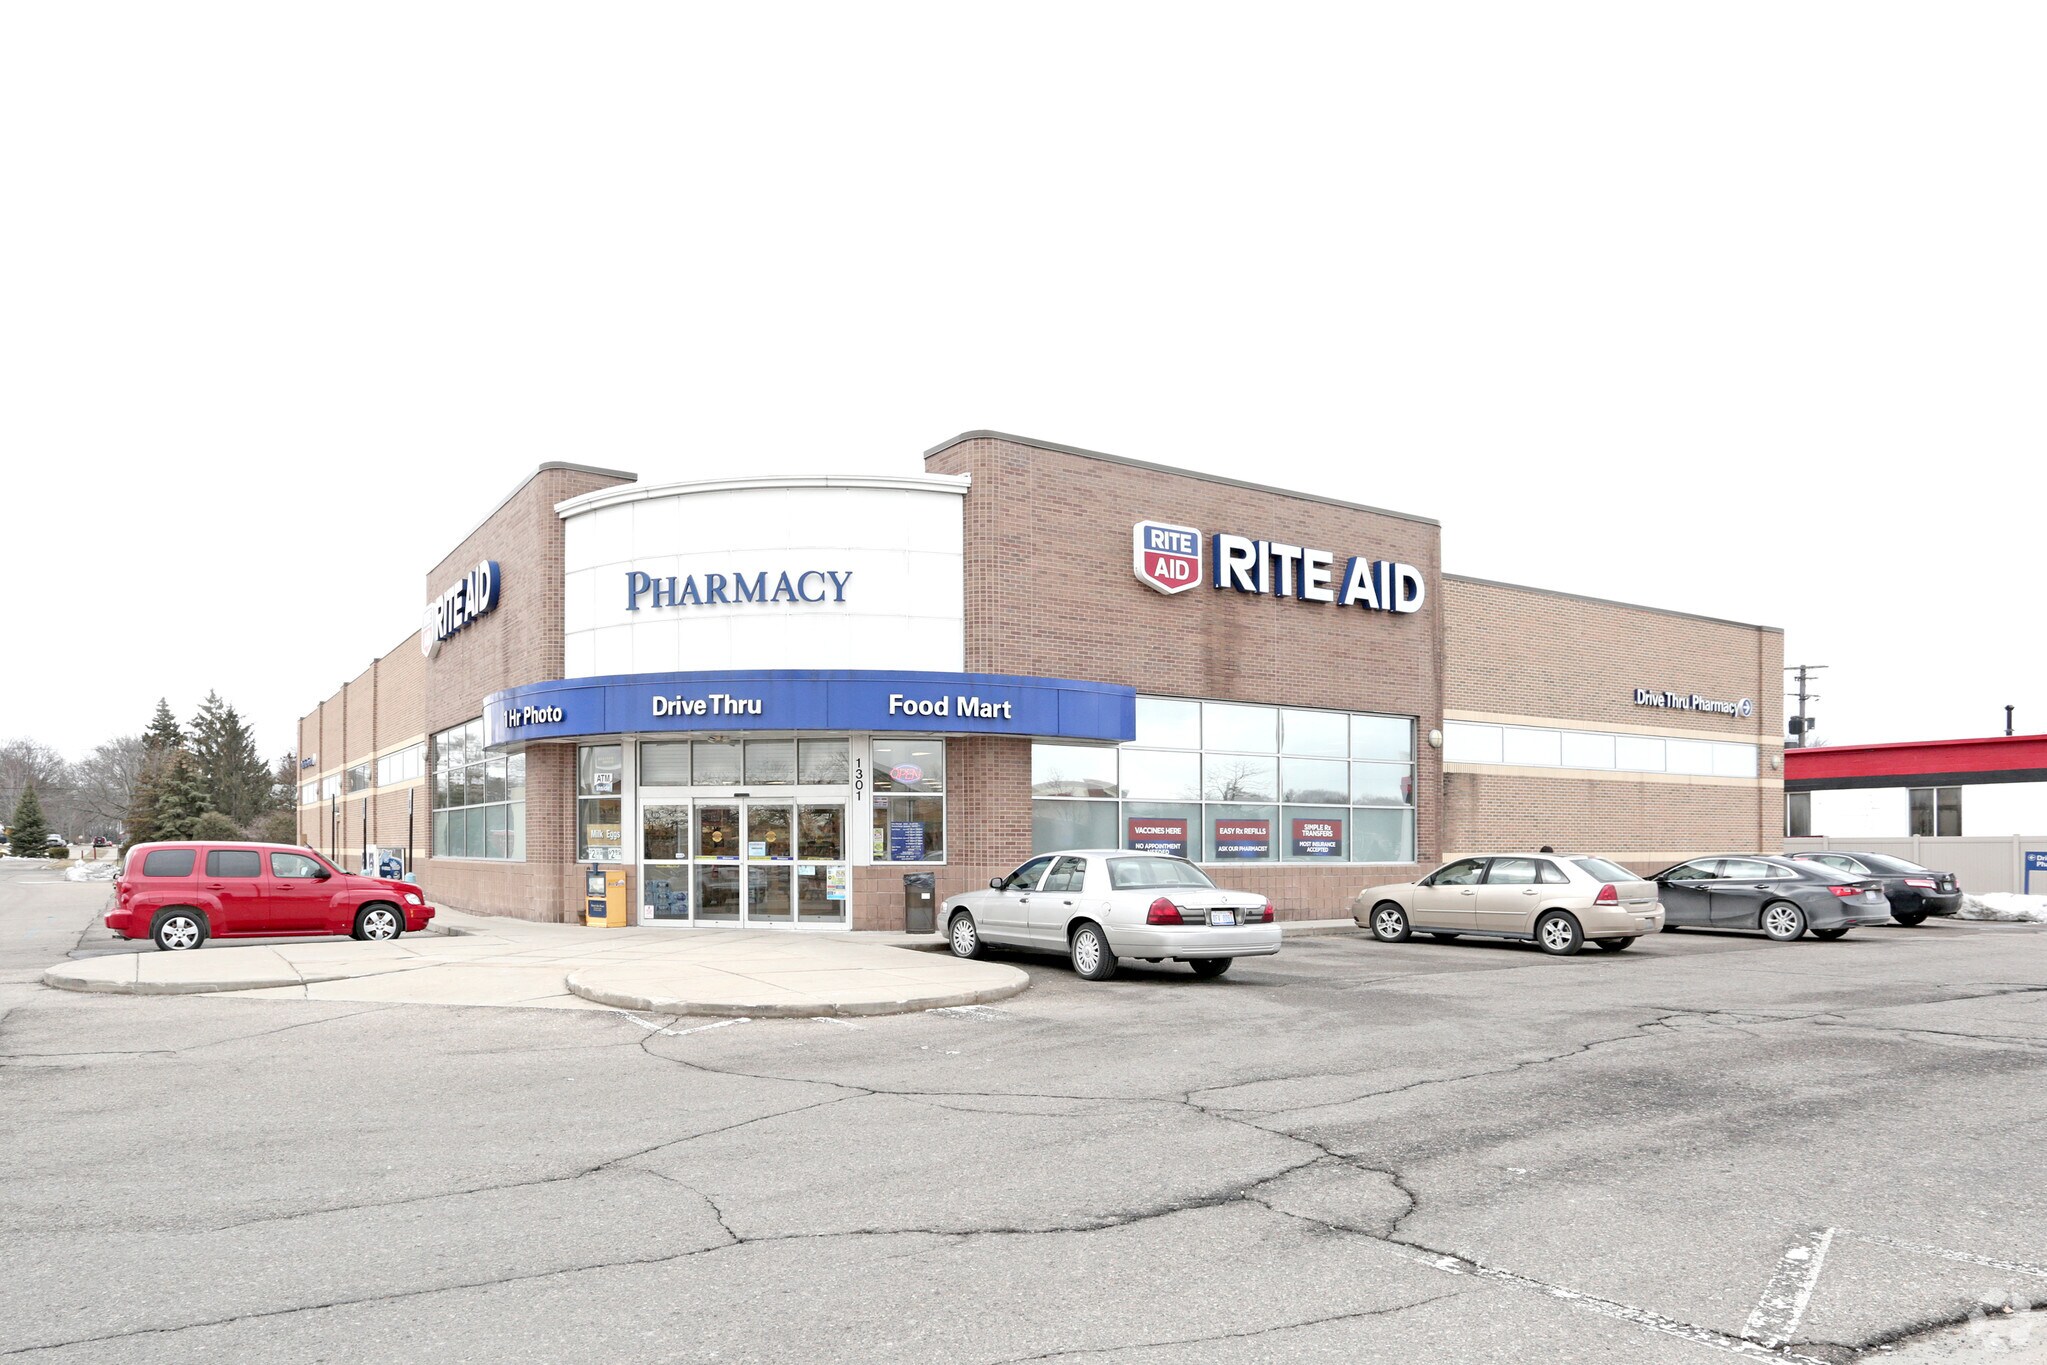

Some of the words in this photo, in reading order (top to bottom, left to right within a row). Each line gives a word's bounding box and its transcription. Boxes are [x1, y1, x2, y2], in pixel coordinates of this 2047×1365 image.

[1150, 529, 1192, 553] RITE
[1154, 557, 1190, 580] AID
[1214, 533, 1333, 602] RITE
[1338, 556, 1425, 614] AID
[436, 578, 468, 642] RITE
[464, 559, 496, 622] AID
[652, 695, 706, 716] Drive
[708, 694, 762, 715] Thru
[889, 693, 949, 716] Food
[957, 696, 1012, 719] Mart
[1635, 688, 1664, 707] Drive
[1664, 691, 1689, 709] Thru
[1691, 694, 1740, 717] Pharmacy
[509, 707, 522, 728] Hr
[523, 706, 562, 726] Photo
[597, 774, 610, 782] ATM
[855, 758, 864, 801] 1301
[889, 766, 922, 781] OPEN
[591, 829, 604, 839] Milk
[606, 829, 621, 841] Eggs
[1135, 826, 1165, 835] VACCINES
[1165, 827, 1182, 835] HERE
[1219, 827, 1235, 835] EASY
[1244, 827, 1266, 835] REFILLS
